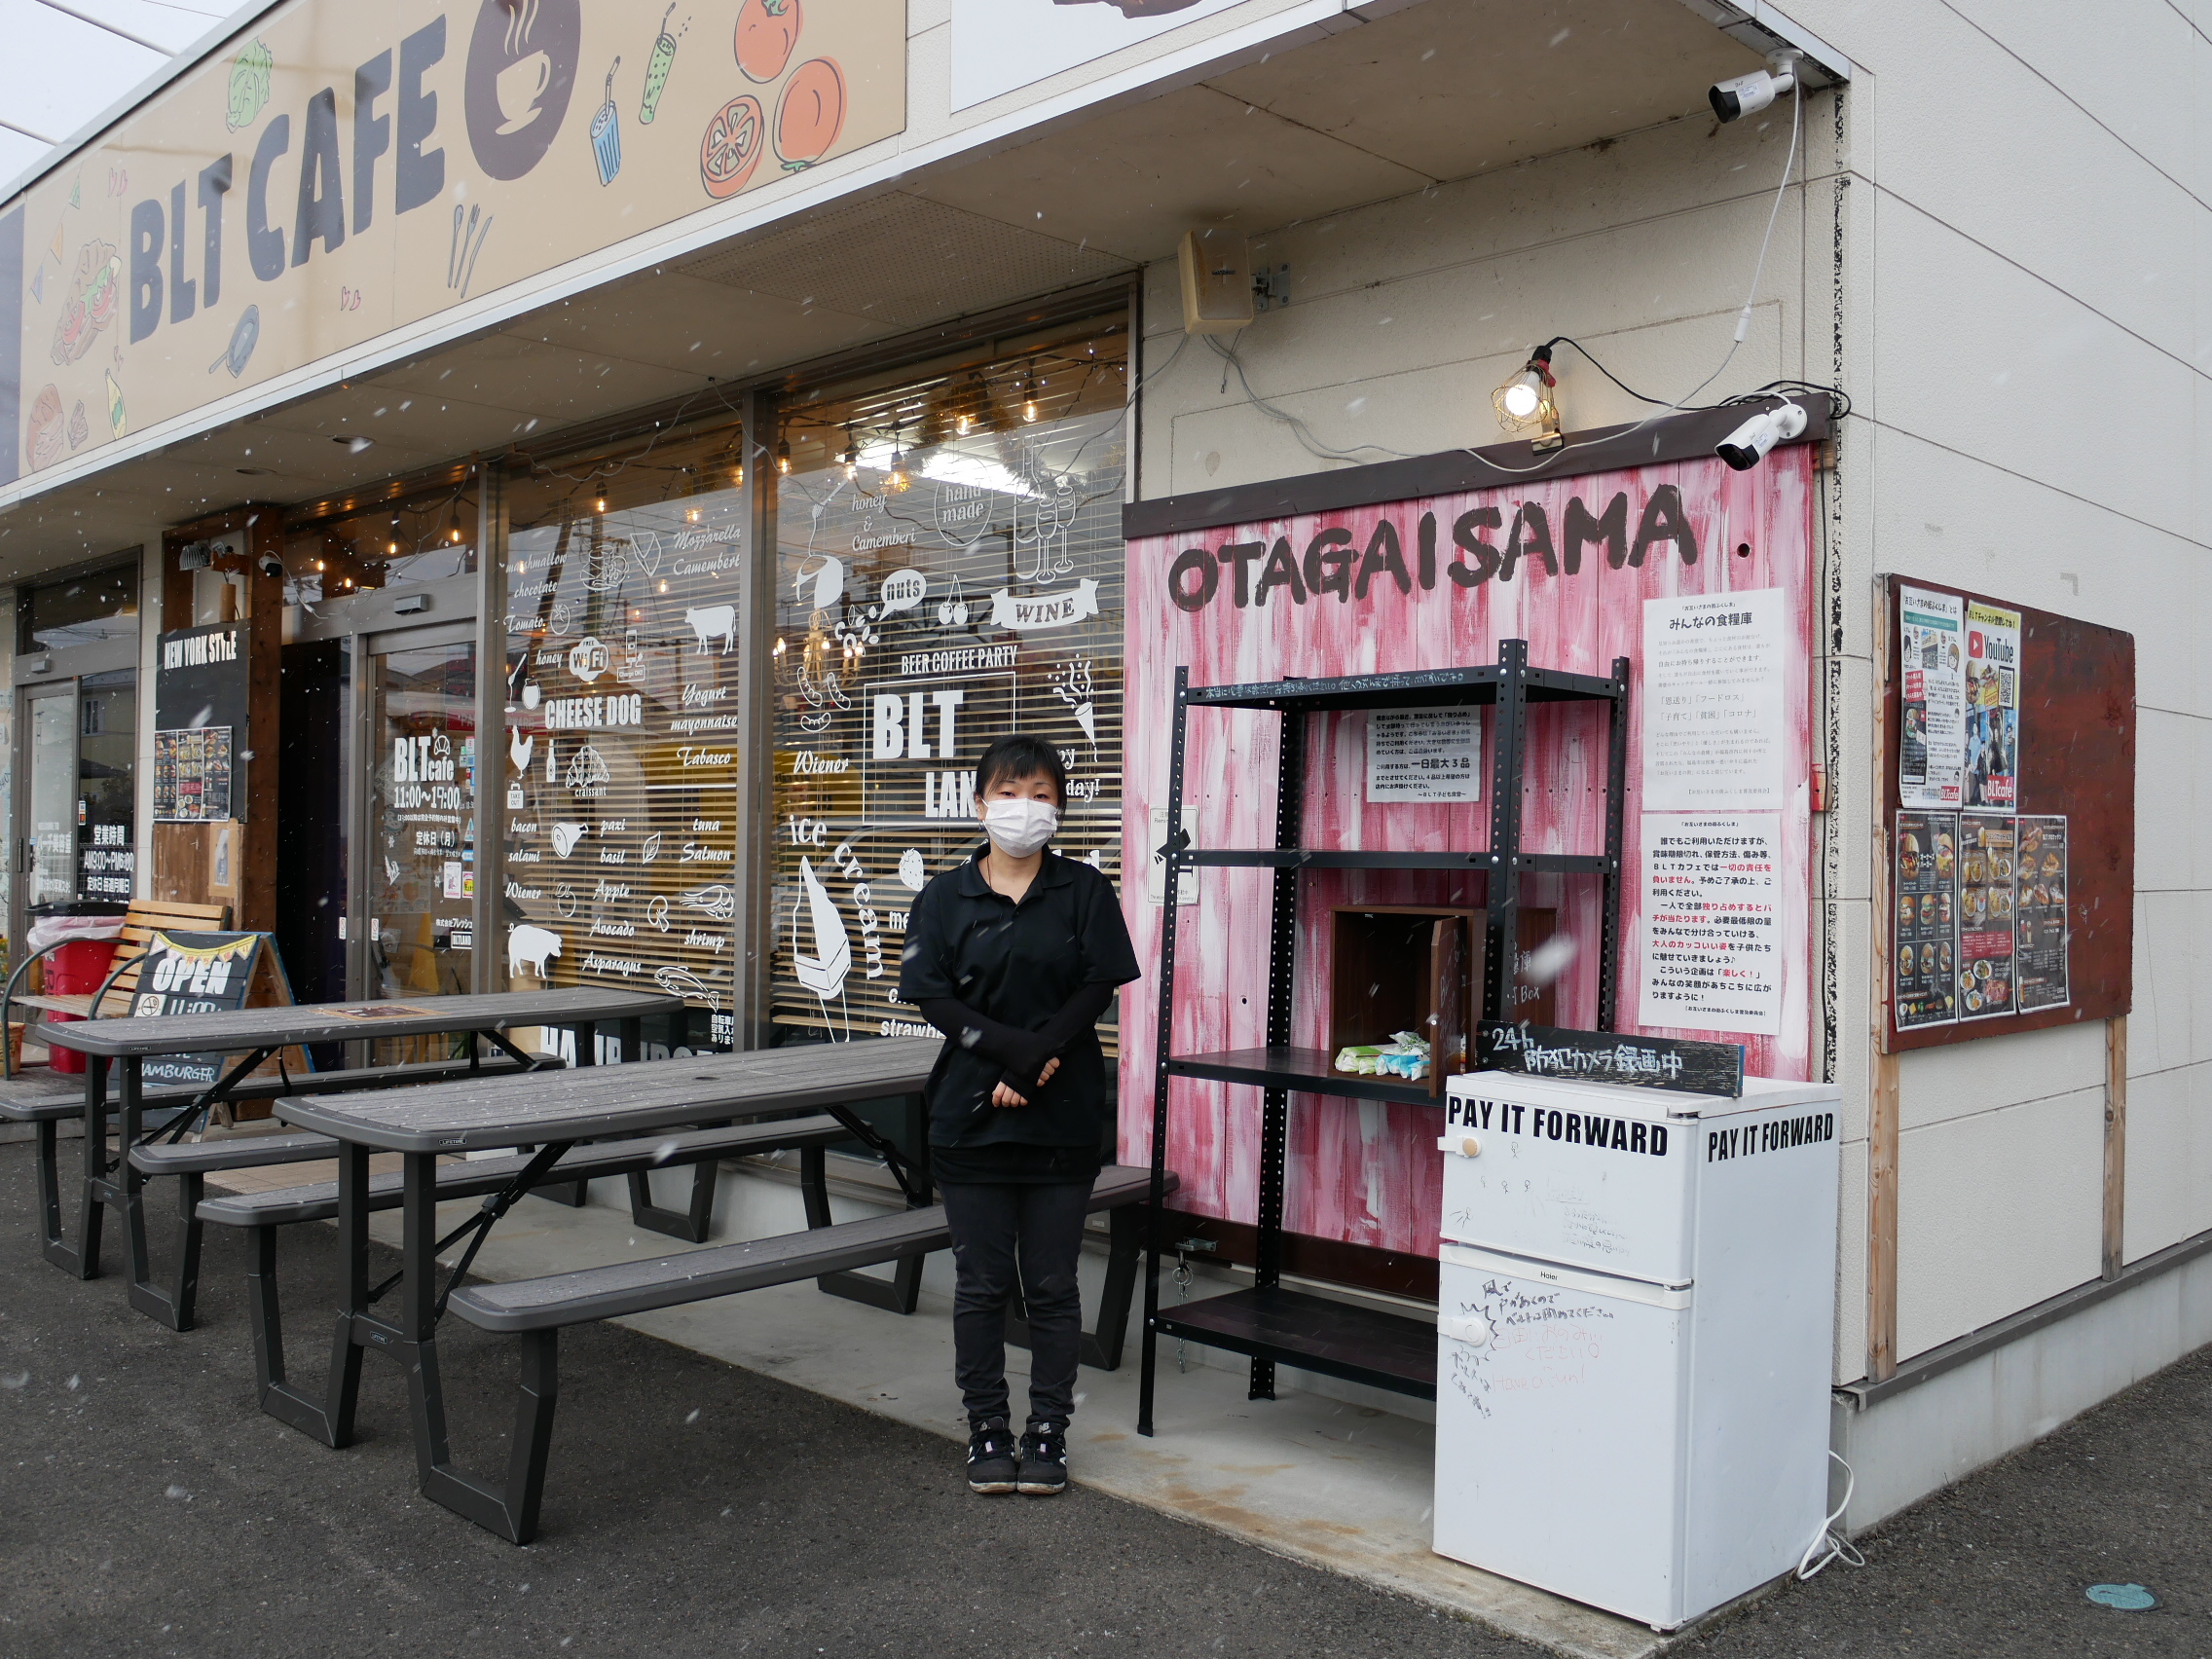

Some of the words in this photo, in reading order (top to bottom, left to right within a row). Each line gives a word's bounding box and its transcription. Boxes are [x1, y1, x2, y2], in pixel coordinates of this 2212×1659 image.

[130, 153, 233, 346] BLT
[246, 14, 446, 282] CAFE
[852, 493, 887, 514] honey
[942, 501, 984, 524] made
[864, 516, 873, 532] &
[673, 524, 742, 550] Mozzarella
[1167, 484, 1699, 612] OTAGAISAMA
[673, 555, 740, 576] Camembert
[514, 581, 557, 598] chocolate
[886, 577, 920, 601] nuts
[1015, 599, 1076, 624] WINE
[1669, 612, 1753, 631] みんなの食糧庫
[503, 614, 543, 634] Tomato
[165, 641, 182, 670] NEW
[184, 635, 208, 666] YORK
[208, 631, 237, 662] STYLE
[535, 648, 563, 668] honey
[1984, 635, 2013, 663] YouTube
[901, 653, 929, 675] BEER
[932, 649, 977, 672] COFFEE
[977, 645, 1018, 668] PARTY
[682, 683, 726, 709] Yogurt
[544, 696, 603, 729] CHEESE
[607, 694, 642, 726] DOG
[670, 716, 738, 736] mayonnaise
[873, 690, 964, 759] BLT
[394, 736, 431, 782] BLT
[428, 756, 454, 781] cafe
[677, 747, 730, 767] Tabasco
[793, 751, 850, 774] Wiener
[575, 787, 607, 797] craissant
[926, 771, 977, 818] LAN
[1987, 778, 2012, 798] BLTcafe
[511, 817, 537, 832] bacon
[692, 818, 719, 831] tuna
[789, 814, 828, 847] ice
[93, 825, 125, 845] 営業時間
[1660, 836, 1768, 846] 誰でもご利用いただけますが、
[508, 849, 540, 863] salami
[600, 847, 626, 864] basil
[679, 842, 730, 863] Salmon
[1652, 850, 1772, 860] 賞味期限切れ、保管方法、傷み等、
[1652, 875, 1772, 886] 負いません。予めご了承の上、ご
[505, 882, 541, 900] Wiener
[593, 879, 630, 903] Apple
[1652, 889, 1703, 898] 利用ください。
[834, 842, 884, 980] cream
[1660, 902, 1772, 912] 一人で全部独り占めするとバ
[590, 917, 634, 937] Avocado
[1652, 914, 1772, 926] チが当たります。必要最低限の量
[684, 929, 724, 955] shrimp
[1652, 927, 1760, 939] をみんなで分け合っていける、
[1652, 940, 1772, 952] 大人のカッコいい姿を子供たち
[582, 950, 642, 974] Asparagus
[1660, 966, 1761, 978] こういう企画は「楽しく！」
[152, 958, 233, 994] OPEN
[1652, 978, 1772, 992] みんなの笑顔があちこちに広が
[1652, 991, 1705, 1001] りますように！
[1525, 1045, 1682, 1079] 防犯カメラ録画中
[1449, 1095, 1493, 1129] PAY
[1501, 1103, 1526, 1135] IT
[1533, 1107, 1669, 1157] FORWARD
[1709, 1128, 1738, 1162] PAY
[1743, 1124, 1758, 1156] IT
[1761, 1113, 1833, 1153] FORWARD
[1540, 1271, 1558, 1280] Haier
